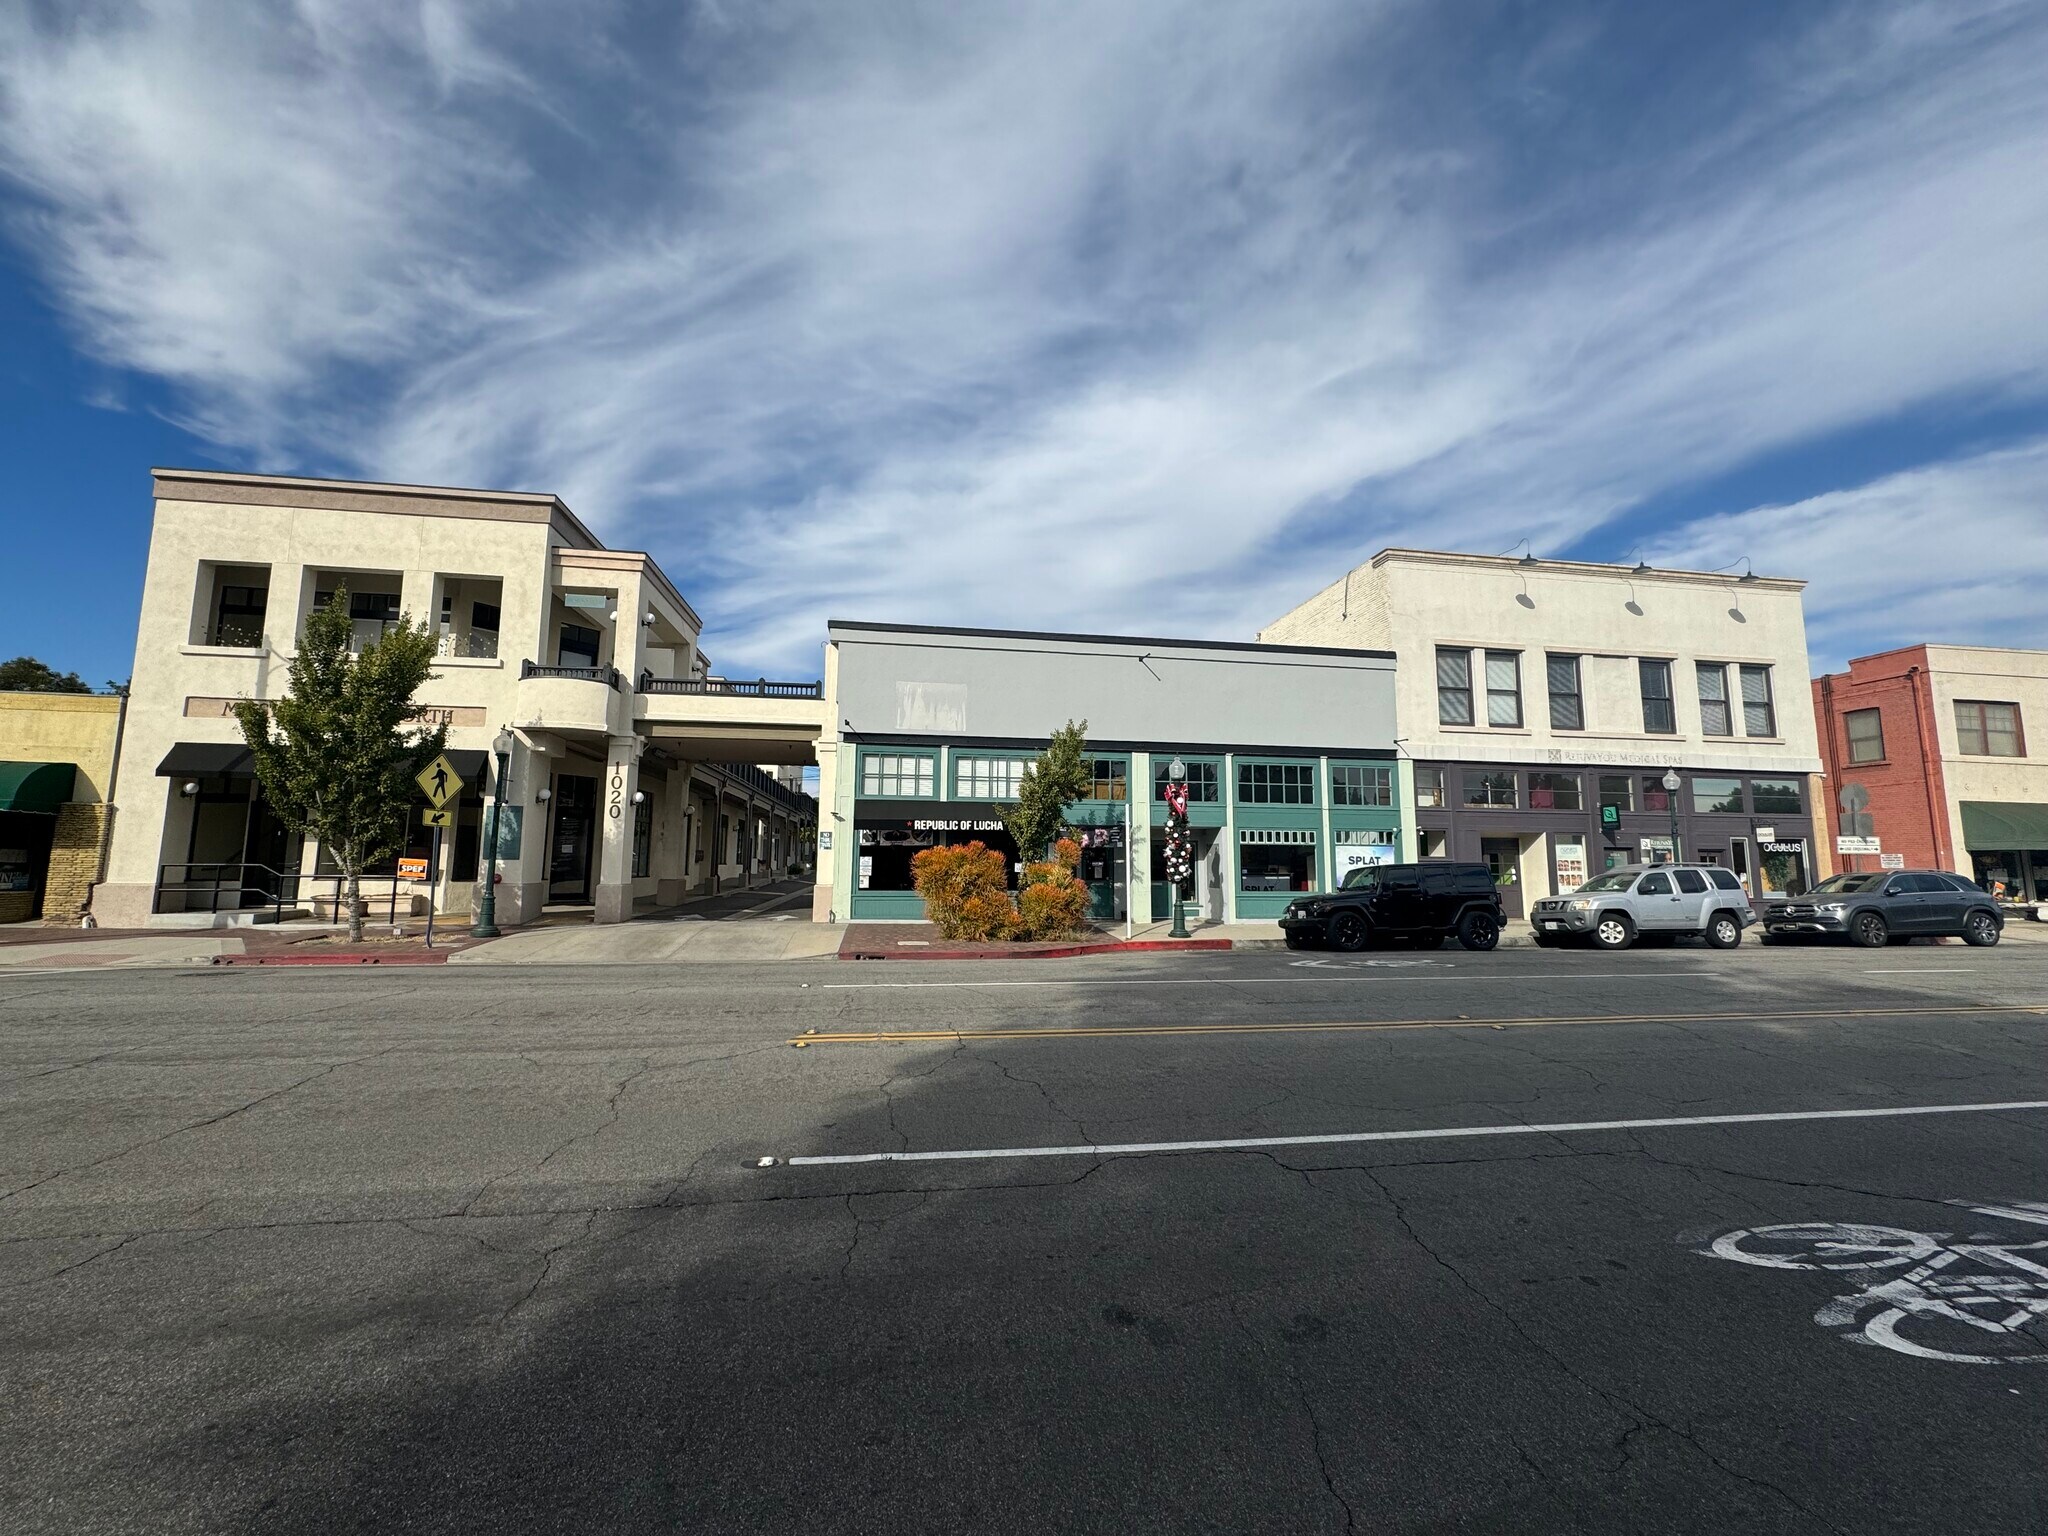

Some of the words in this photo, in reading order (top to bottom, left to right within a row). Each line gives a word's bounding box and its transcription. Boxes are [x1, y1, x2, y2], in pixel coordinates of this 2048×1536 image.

[1662, 754, 1683, 765] SPAS
[609, 760, 623, 819] 1020
[914, 820, 959, 831] REPUBLIC
[960, 820, 972, 831] OF
[973, 820, 1004, 831] LUCHA
[1763, 842, 1802, 853] OCULUS
[1348, 855, 1382, 866] SPLAT
[401, 865, 424, 873] SPEF
